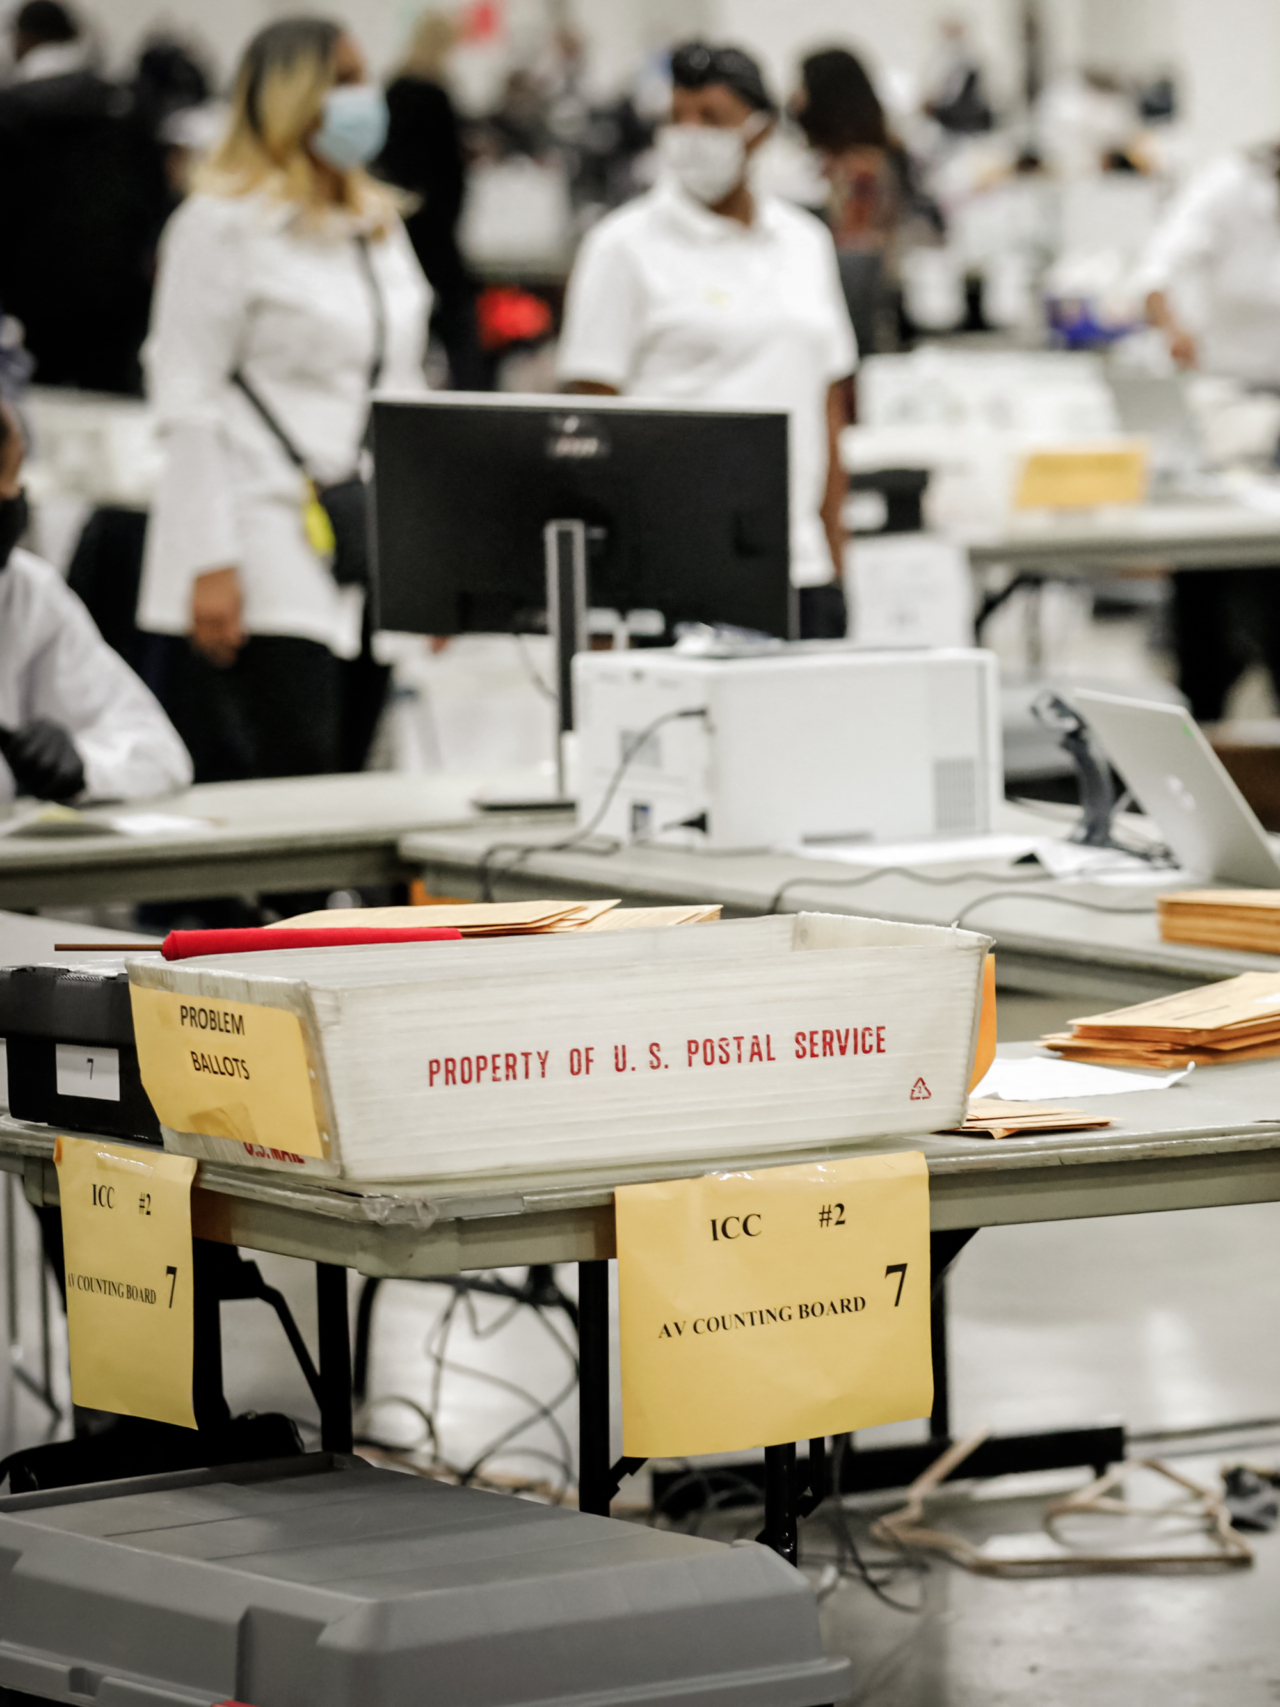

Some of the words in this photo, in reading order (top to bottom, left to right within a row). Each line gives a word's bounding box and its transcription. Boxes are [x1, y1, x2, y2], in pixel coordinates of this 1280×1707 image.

[179, 1004, 245, 1036] PROBLEM
[86, 1057, 94, 1081] 7
[190, 1050, 250, 1080] BALLOTS
[428, 1049, 549, 1087] PROPERTY
[569, 1046, 594, 1076] OF
[686, 1033, 776, 1067] POSTAL
[794, 1025, 886, 1059] SERVICE
[92, 1183, 115, 1209] ICC
[139, 1192, 151, 1216] #2
[710, 1213, 762, 1241] ICC
[818, 1203, 846, 1228] #2
[67, 1273, 75, 1287] AV
[77, 1274, 125, 1299] COUNTING
[126, 1284, 157, 1305] BOARD
[165, 1265, 178, 1309] 7
[658, 1320, 687, 1339] AV
[692, 1305, 793, 1335] COUNTING
[798, 1296, 866, 1320] BOARD
[884, 1262, 908, 1307] 7
